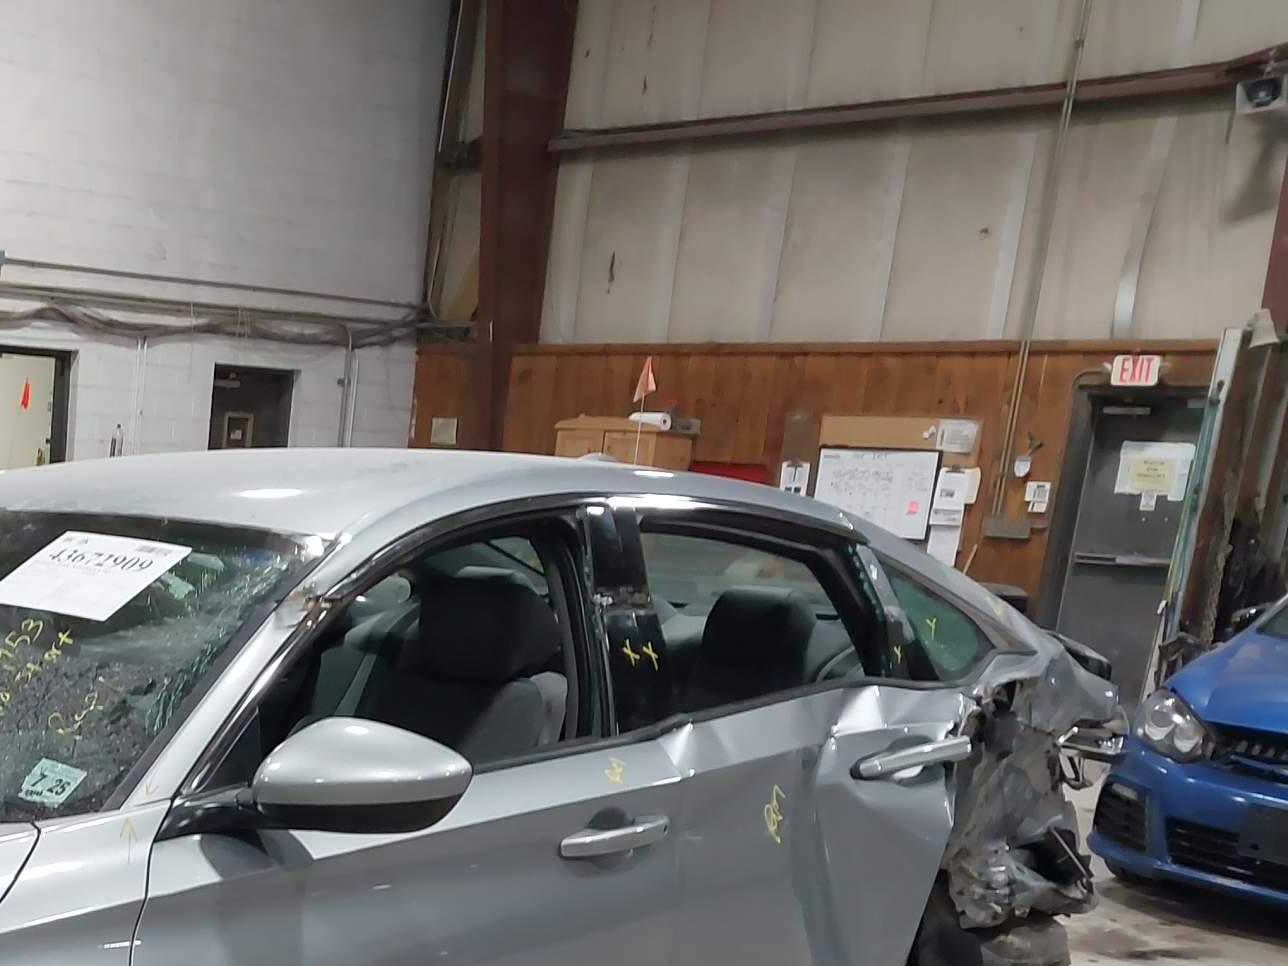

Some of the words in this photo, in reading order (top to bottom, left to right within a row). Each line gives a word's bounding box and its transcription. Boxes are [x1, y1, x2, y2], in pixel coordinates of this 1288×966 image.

[1119, 357, 1154, 384] EXIT
[48, 548, 154, 573] 43672909
[47, 778, 71, 796] 25
